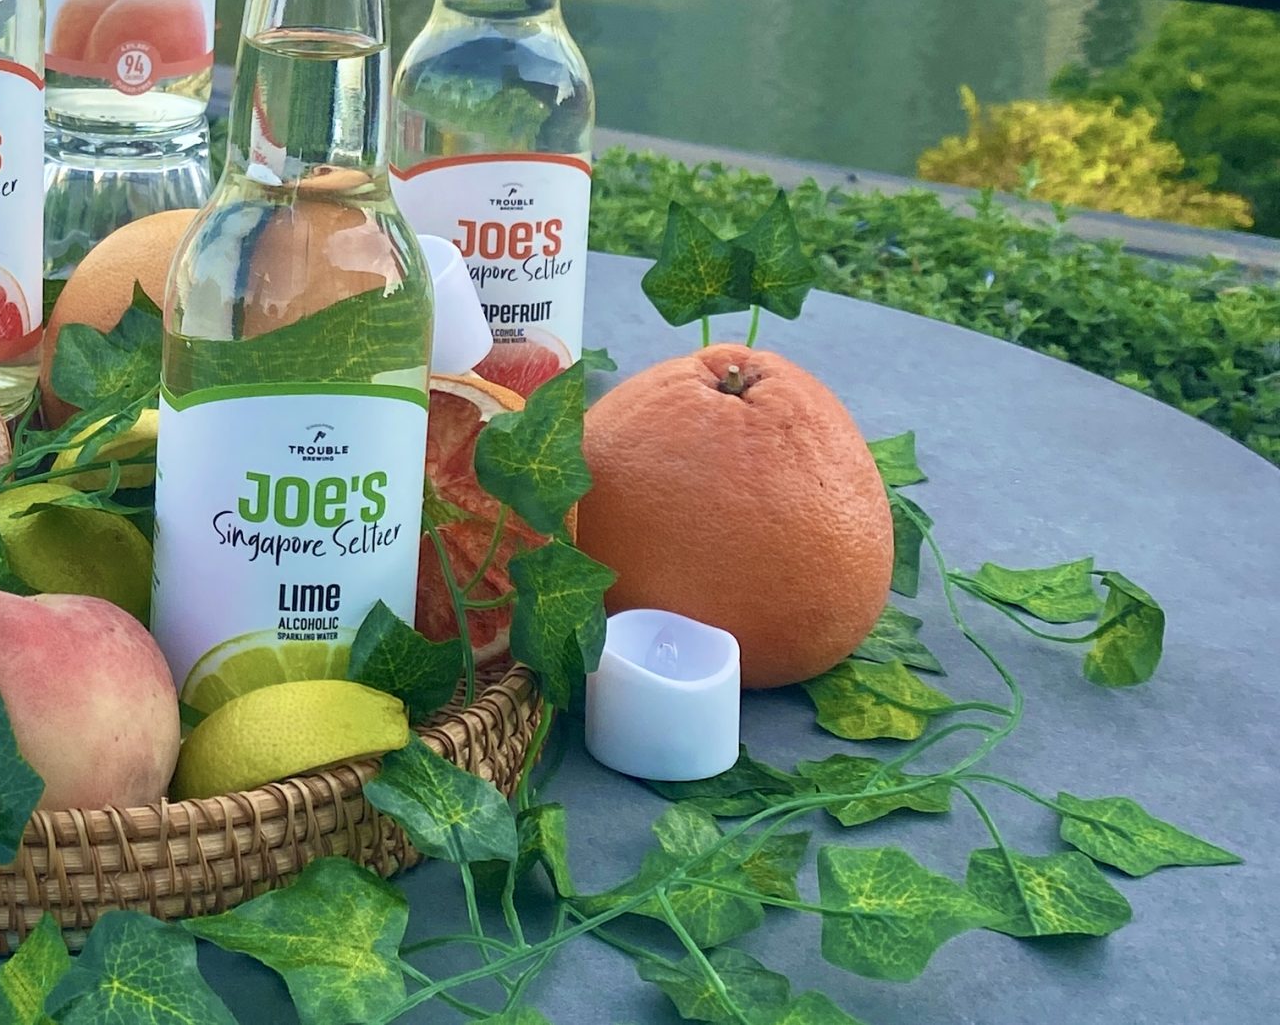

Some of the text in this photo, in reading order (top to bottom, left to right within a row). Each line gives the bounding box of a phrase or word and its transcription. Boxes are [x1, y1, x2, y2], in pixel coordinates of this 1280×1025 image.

[125, 54, 144, 75] 94
[522, 254, 573, 282] Seltzer
[288, 445, 350, 456] TROUBLE
[212, 510, 403, 566] Singapore Seltzer
[278, 616, 339, 631] ALCOHOLIC
[316, 631, 339, 641] WATER
